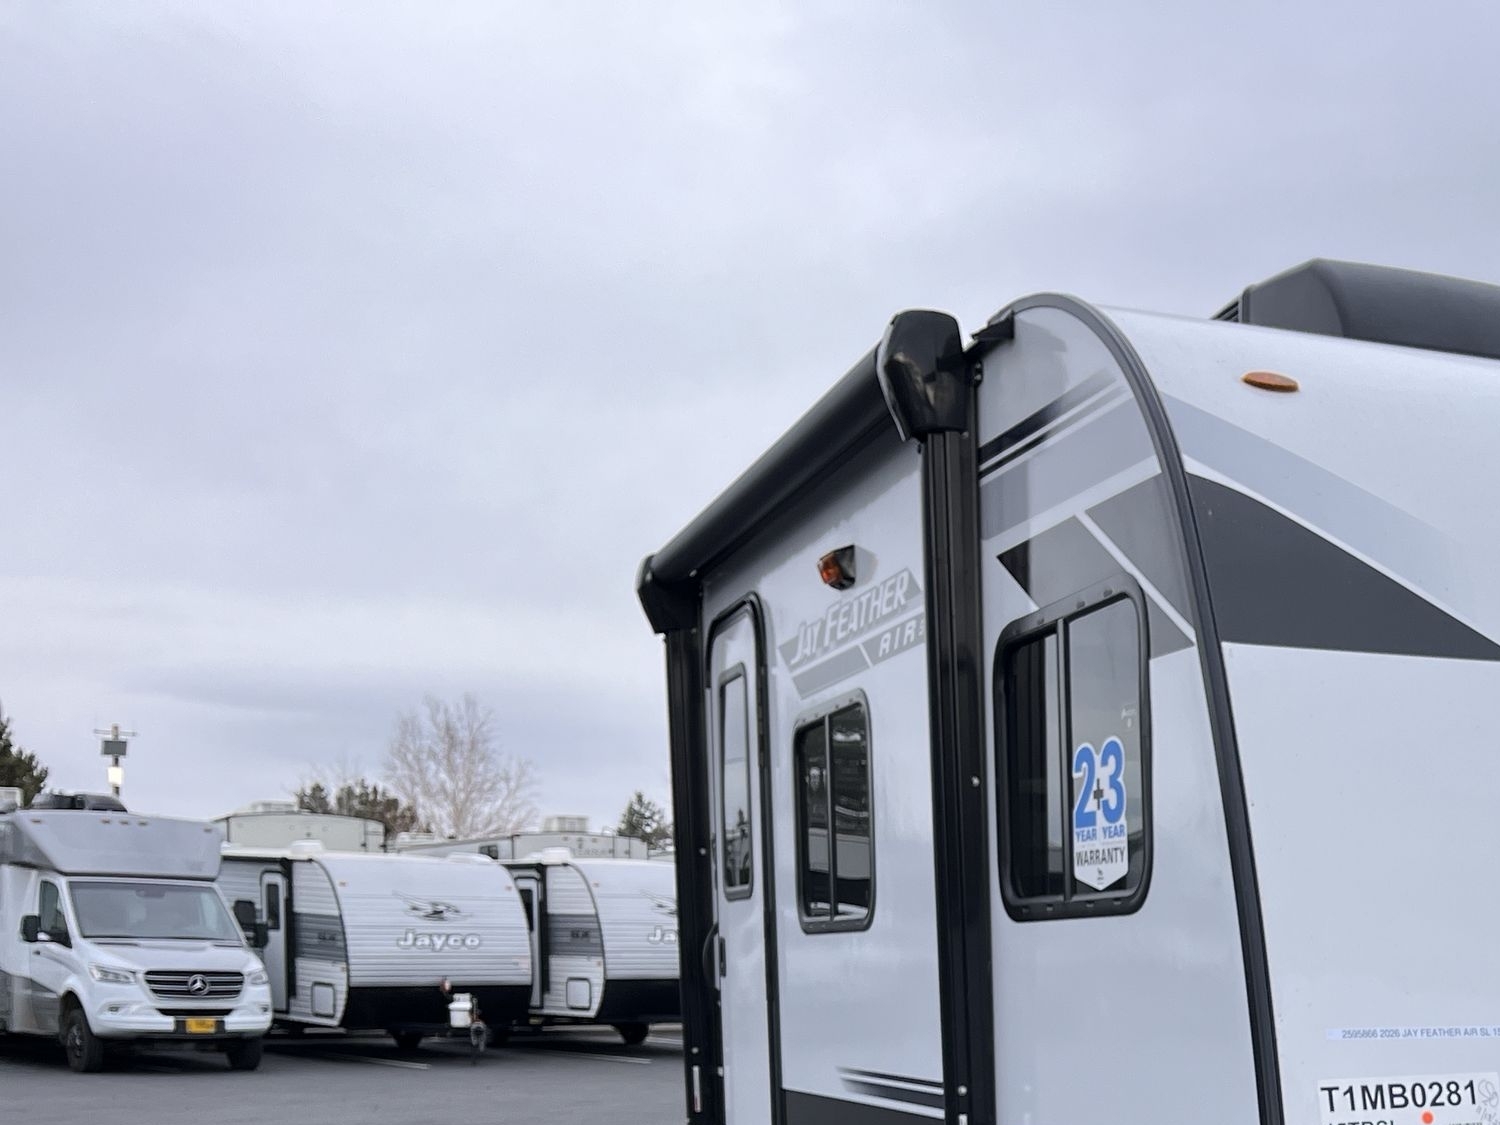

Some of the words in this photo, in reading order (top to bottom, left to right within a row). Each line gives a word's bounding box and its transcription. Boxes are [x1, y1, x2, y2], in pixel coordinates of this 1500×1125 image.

[789, 620, 822, 666] JAY
[823, 569, 910, 648] FEATHER
[1075, 828, 1098, 843] YEAR
[1101, 824, 1126, 840] YEAR
[1075, 846, 1126, 867] WARRANTY
[397, 928, 481, 952] Jayco
[1402, 1028, 1419, 1038] JAY
[1420, 1028, 1462, 1038] FEATHER
[1463, 1028, 1479, 1037] AIR
[1480, 1028, 1491, 1037] SL
[1320, 1079, 1477, 1113] T1MB0281
